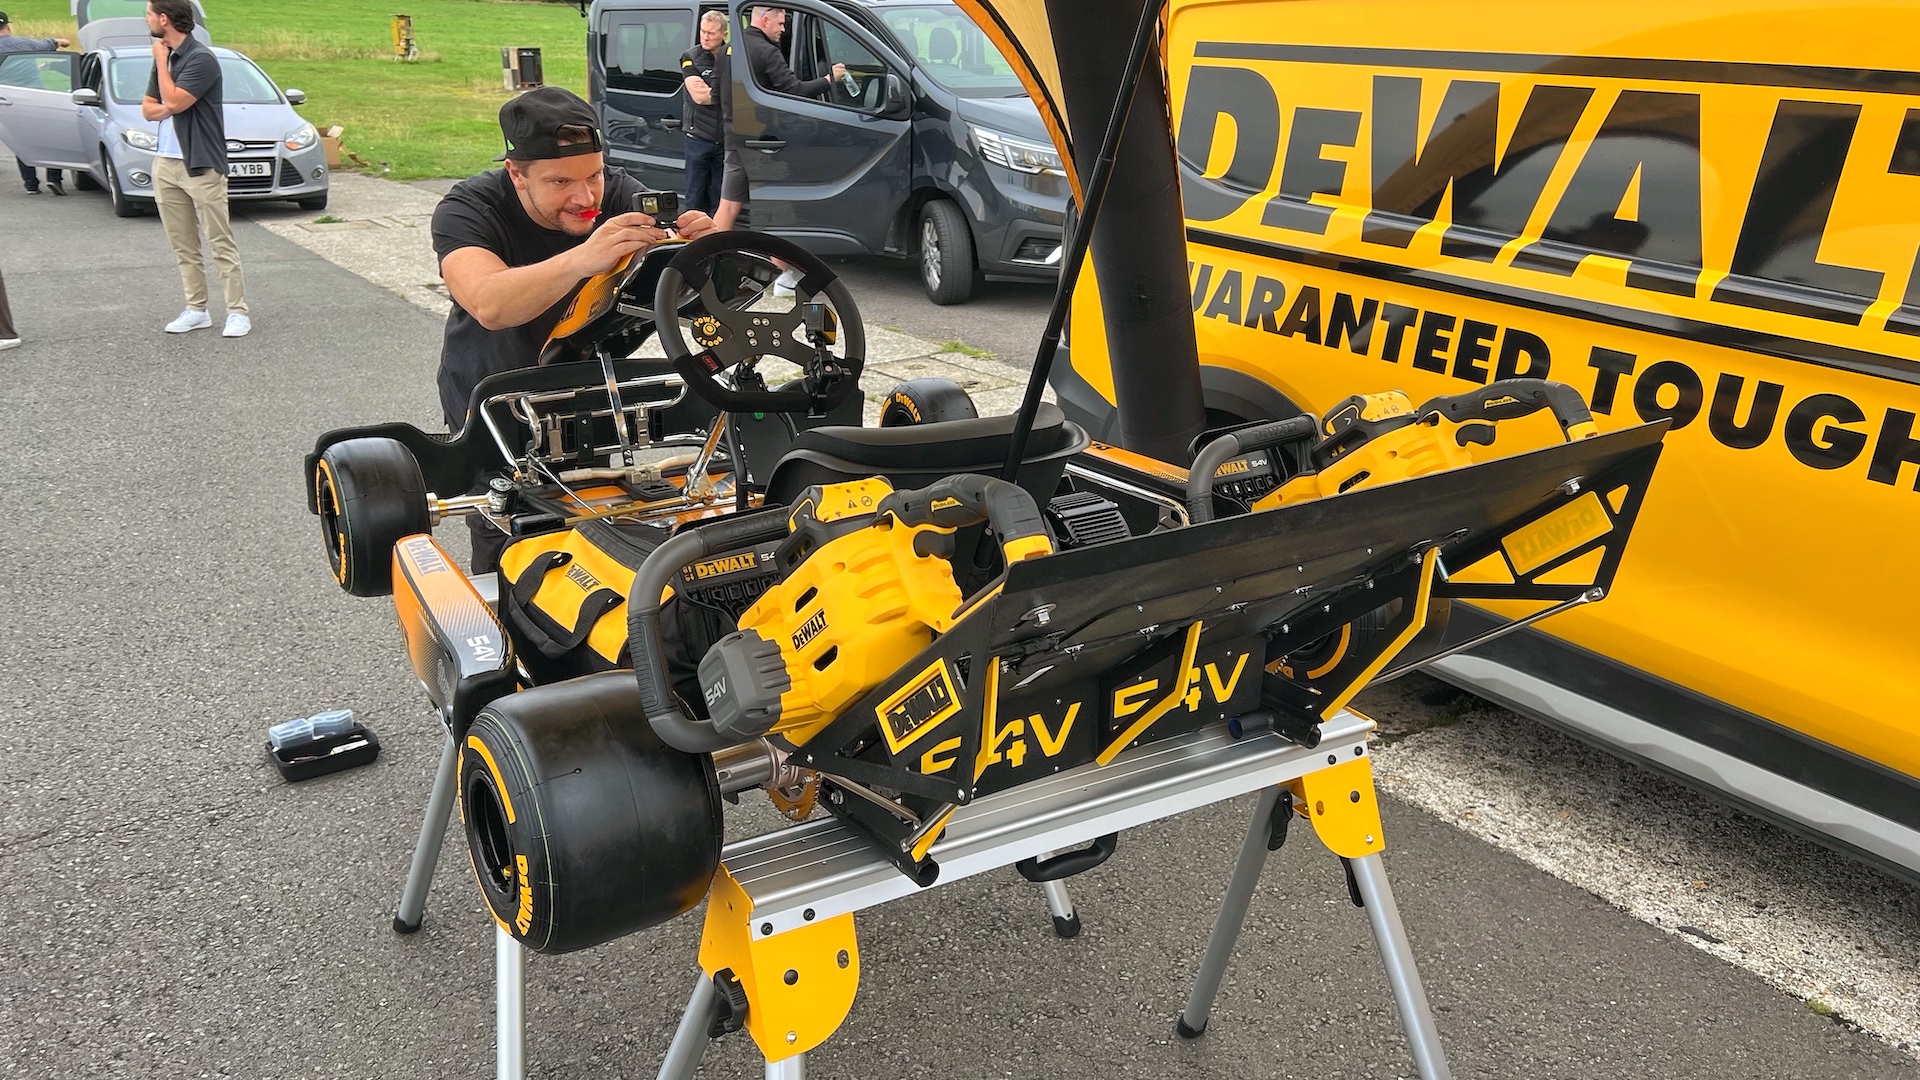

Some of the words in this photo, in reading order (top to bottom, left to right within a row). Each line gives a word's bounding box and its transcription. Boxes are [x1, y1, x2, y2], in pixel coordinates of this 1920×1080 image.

[241, 164, 264, 174] YBB
[694, 316, 721, 329] POWER
[1188, 261, 1551, 385] UARANTEED
[696, 336, 723, 347] BOOST
[895, 392, 922, 423] DEWALT
[1214, 460, 1250, 476] EWALT
[1251, 459, 1268, 468] 54V
[406, 540, 449, 576] DEWALT
[695, 553, 758, 579] DEWALT
[566, 564, 600, 592] DEWALT
[791, 610, 827, 651] DEWALT
[466, 634, 500, 662] 54V
[704, 677, 728, 707] 54V
[885, 674, 956, 741] DEWALT
[515, 854, 533, 936] DEWALT
